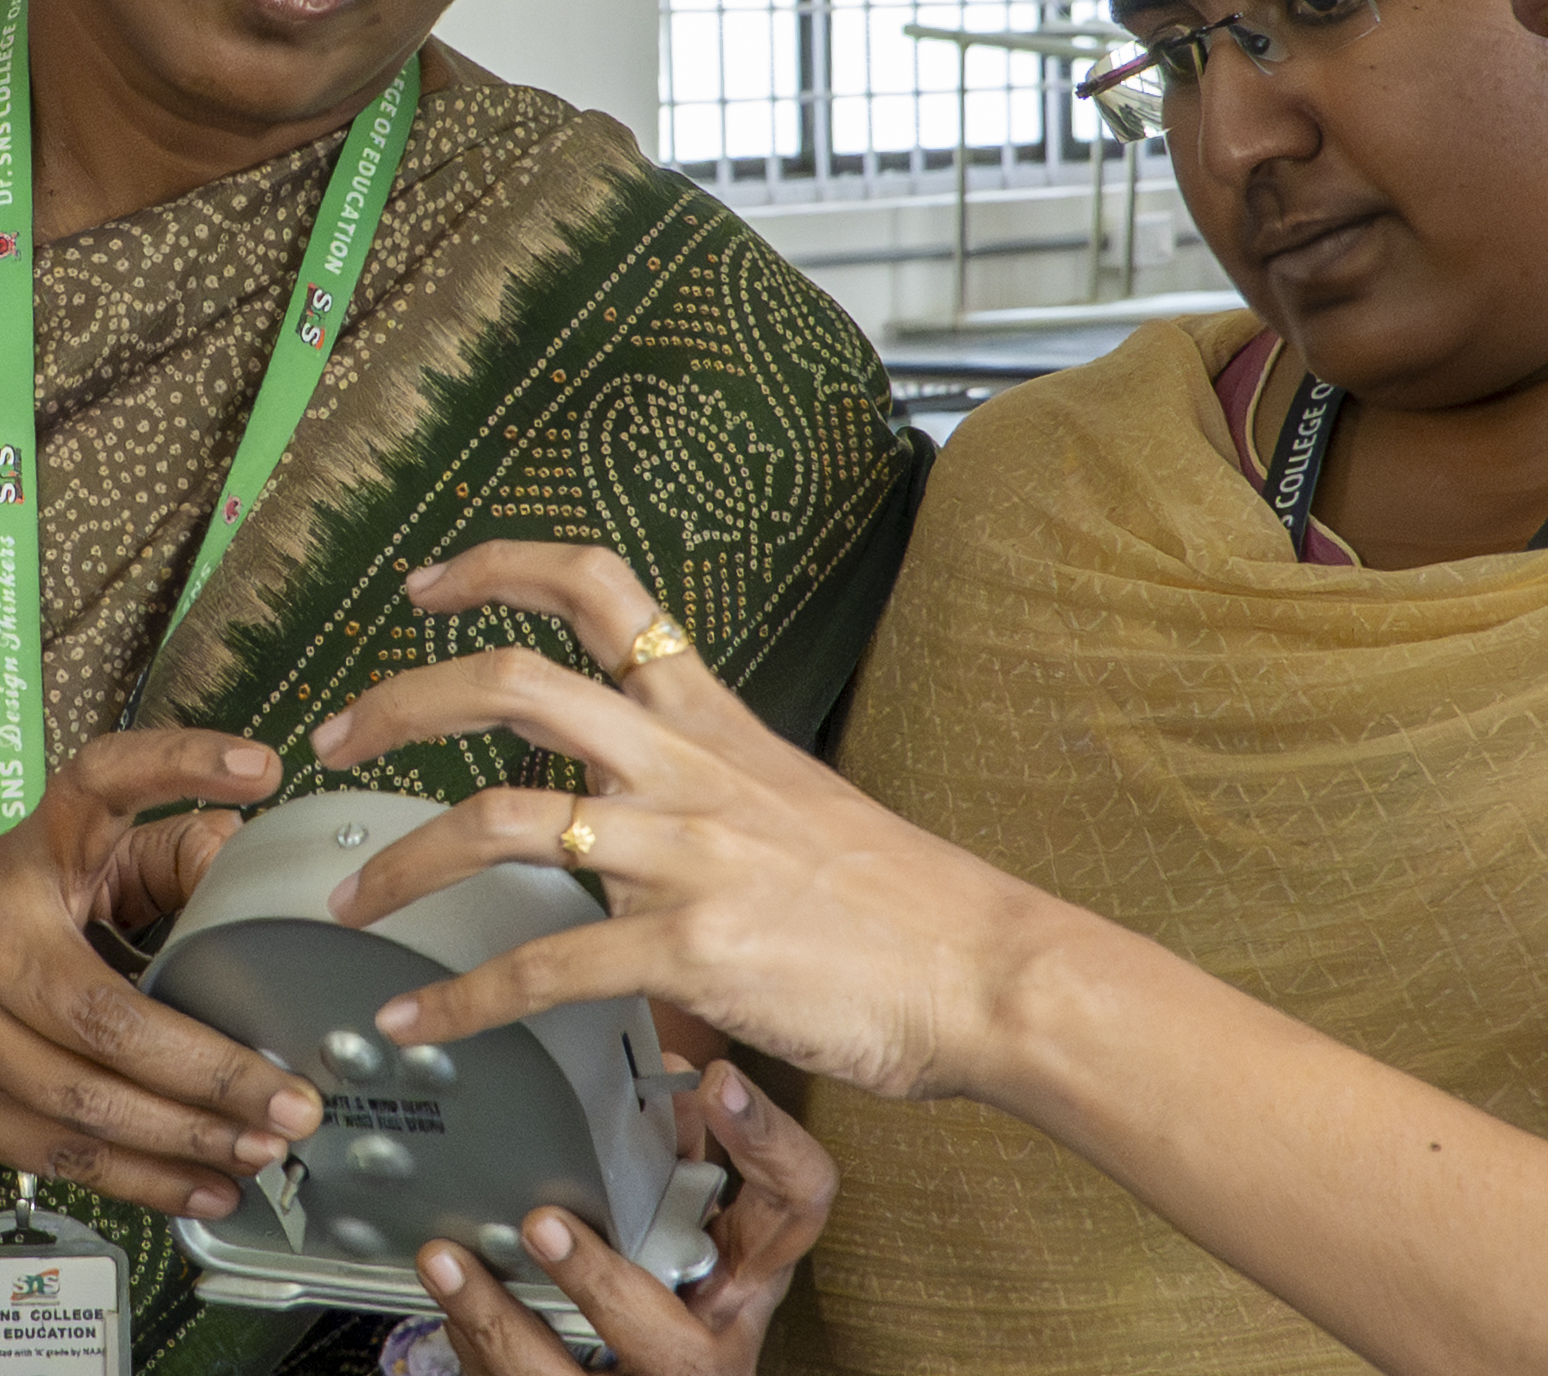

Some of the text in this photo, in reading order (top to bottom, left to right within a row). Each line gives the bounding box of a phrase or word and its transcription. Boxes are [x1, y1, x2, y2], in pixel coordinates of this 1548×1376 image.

[369, 117, 392, 150] OF
[324, 146, 382, 276] EDUCATION
[1274, 402, 1328, 509] COLLEGE
[0, 759, 26, 820] SNS
[4, 1326, 97, 1340] EDUCATION
[30, 1308, 104, 1322] COLLEGE
